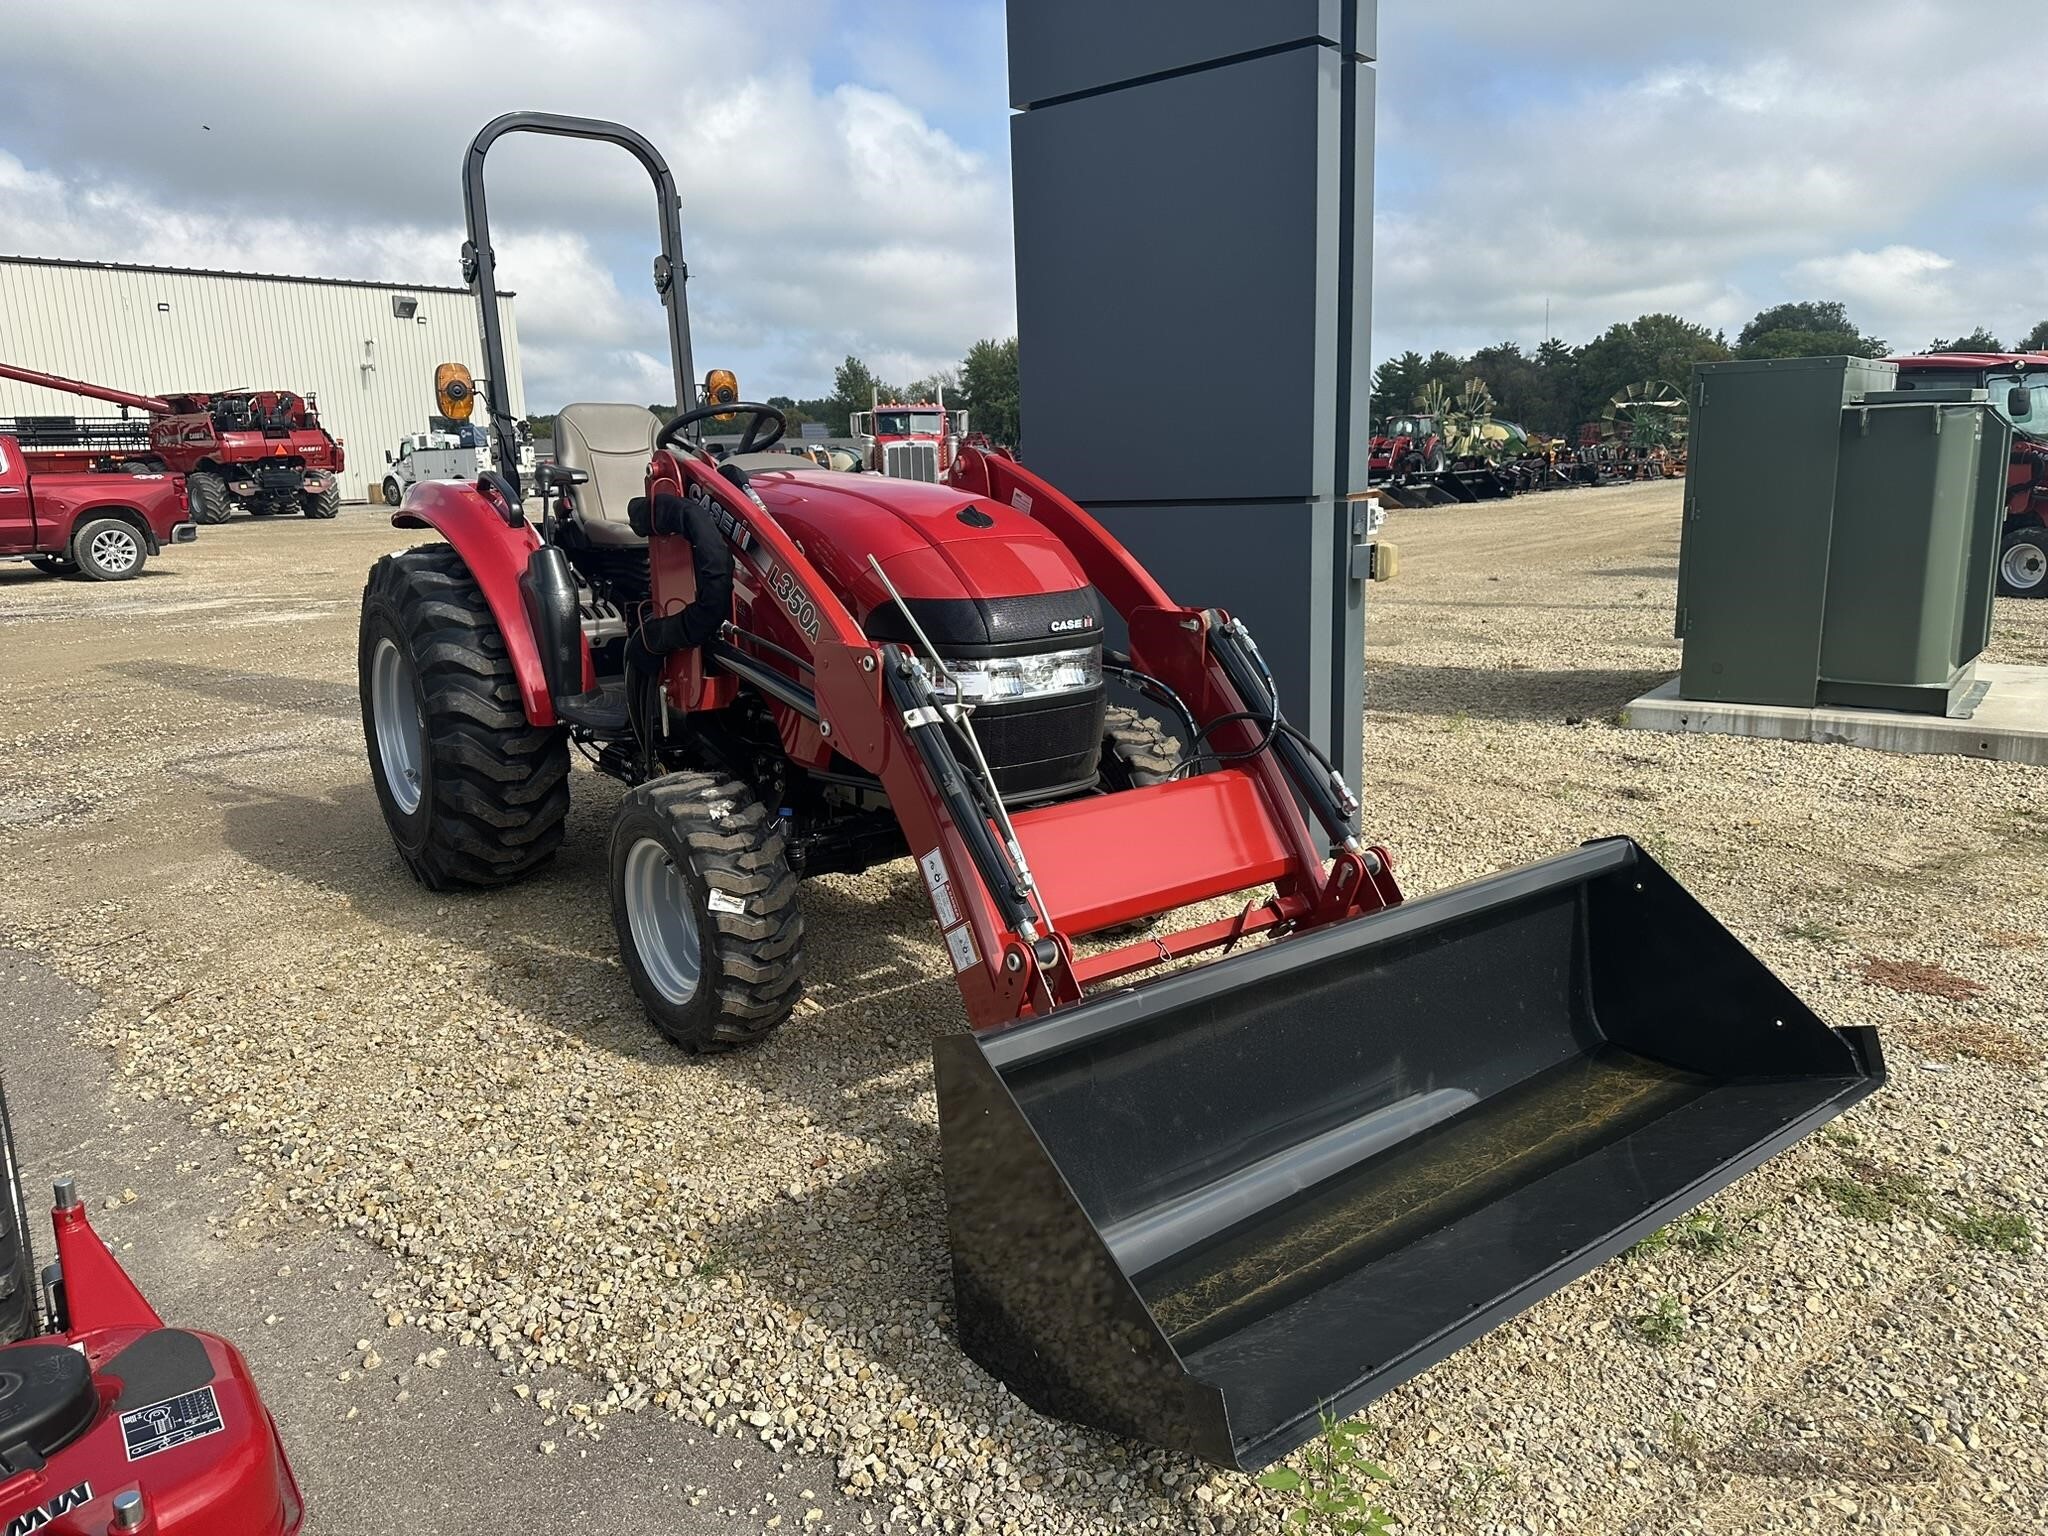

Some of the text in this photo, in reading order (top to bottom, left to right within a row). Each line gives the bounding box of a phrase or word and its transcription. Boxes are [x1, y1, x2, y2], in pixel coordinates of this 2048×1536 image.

[689, 483, 734, 534] CASE
[768, 564, 821, 645] L350A
[1050, 619, 1082, 631] CASE
